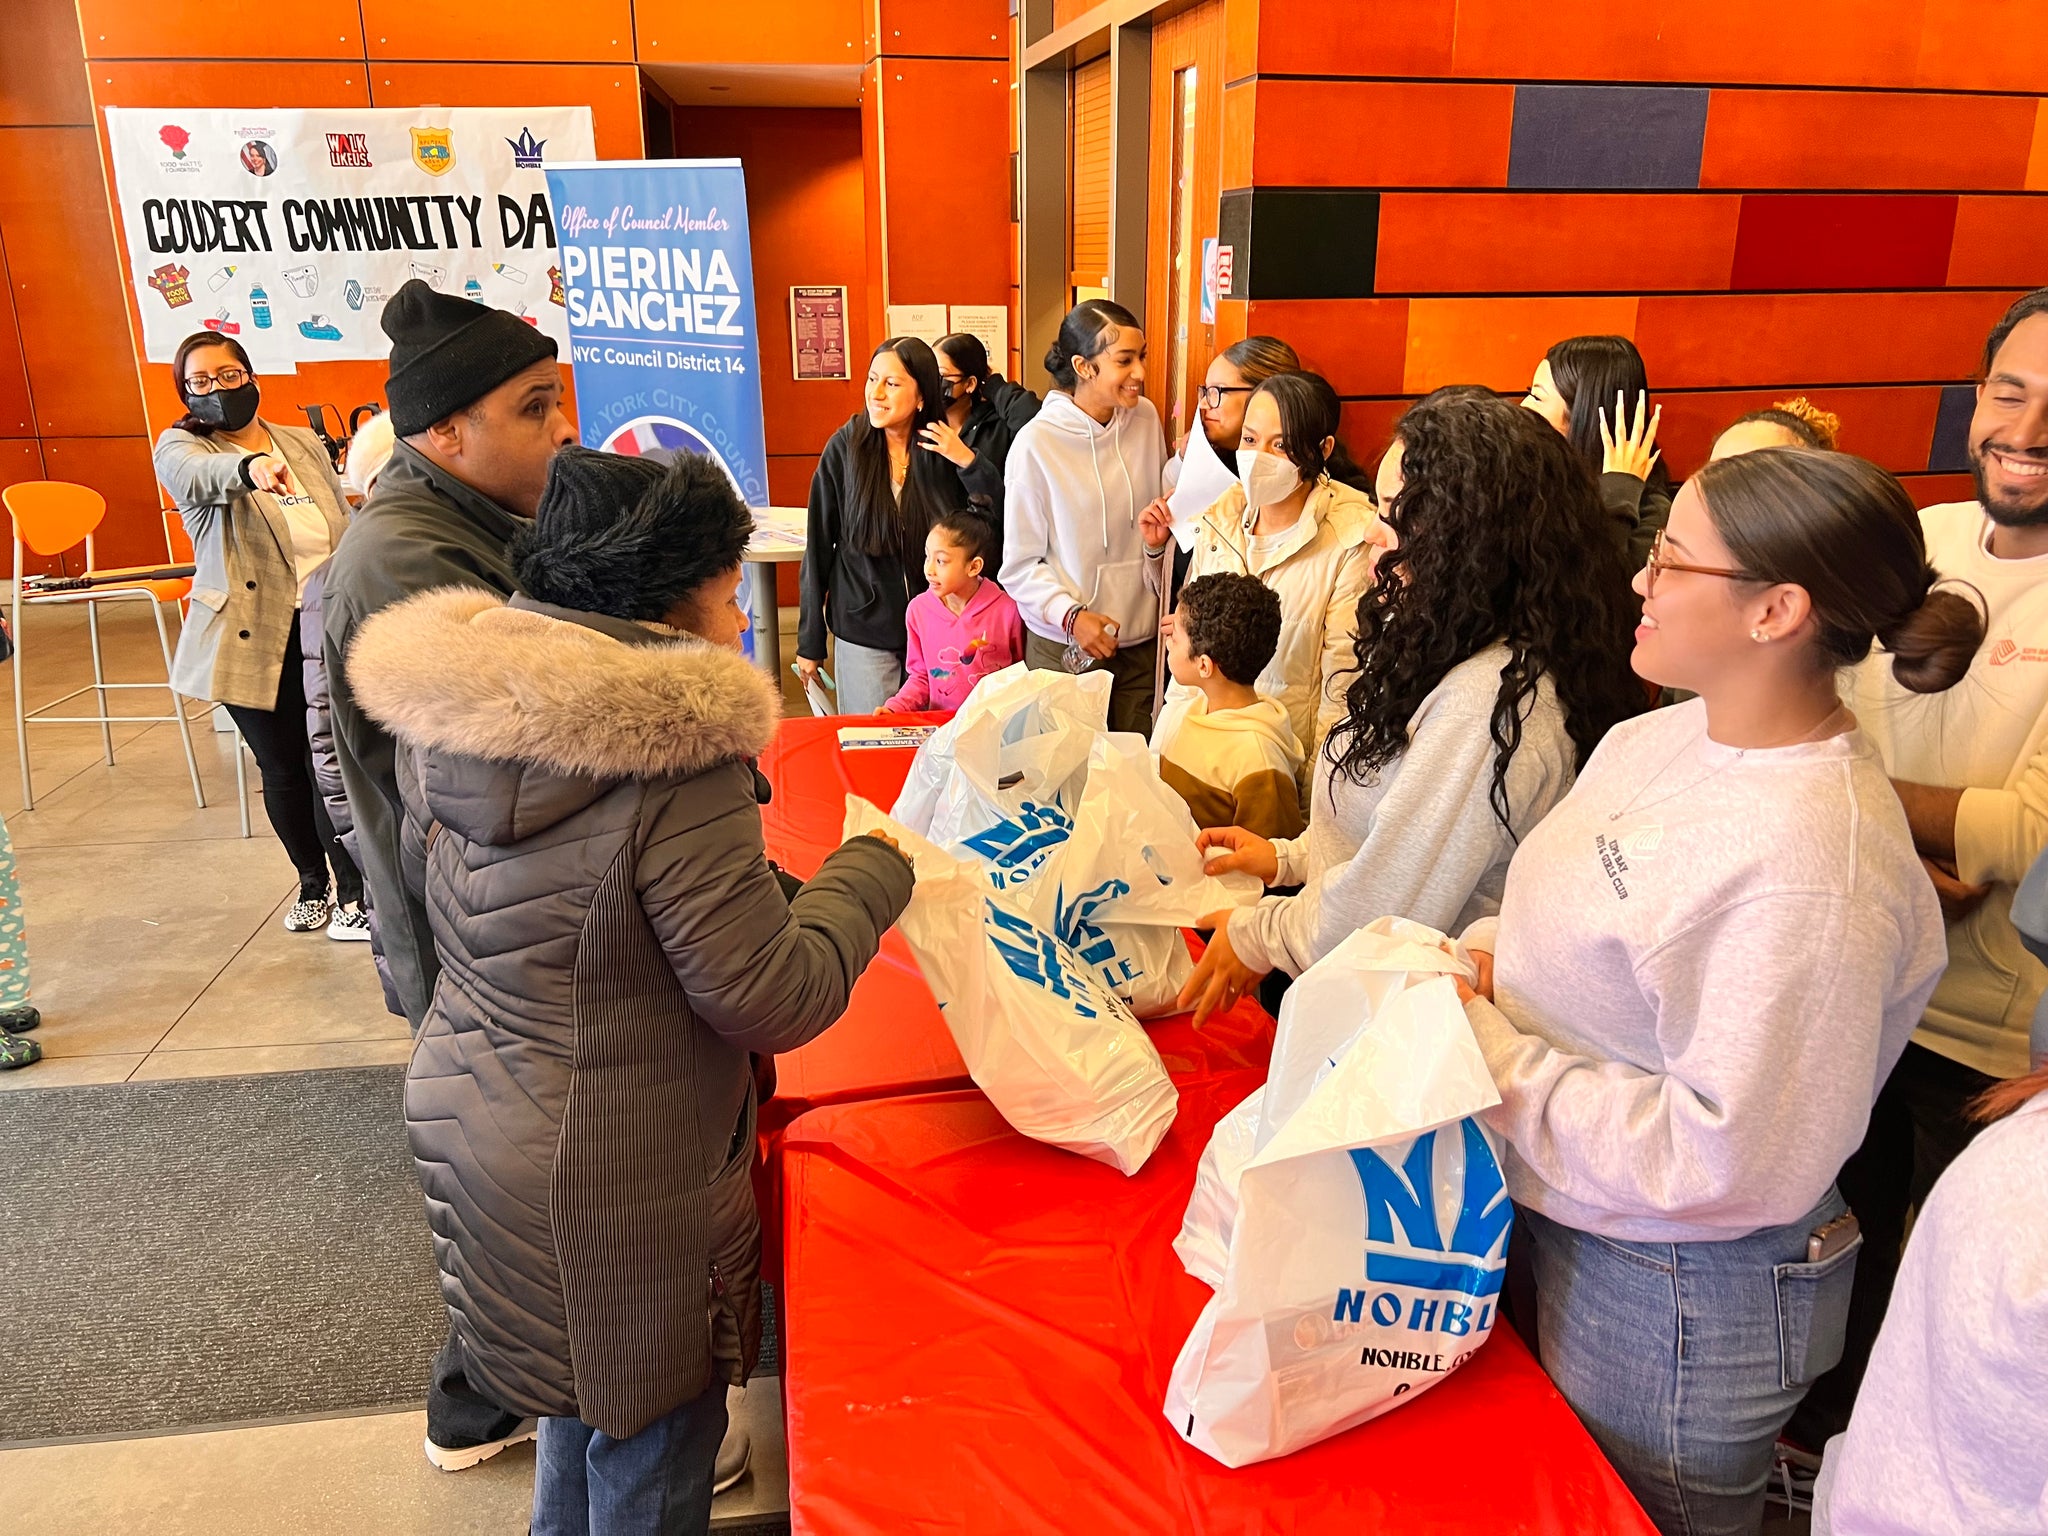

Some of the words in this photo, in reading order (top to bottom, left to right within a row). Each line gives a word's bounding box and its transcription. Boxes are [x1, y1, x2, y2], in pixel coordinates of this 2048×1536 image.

[326, 134, 368, 153] WALK
[143, 198, 272, 253] COUDERT
[282, 195, 482, 252] COMMUNITY
[499, 194, 556, 249] DA
[561, 204, 600, 238] Office
[603, 206, 620, 239] of
[621, 204, 673, 231] Council
[674, 204, 730, 234] Member
[563, 246, 740, 293] PIERINA
[166, 287, 186, 298] FOOD
[169, 294, 190, 305] DRIVE
[567, 288, 744, 336] SANCHEZ
[573, 345, 600, 363] NYC
[604, 347, 662, 368] Council
[667, 351, 722, 373] District
[725, 357, 745, 374] 14
[598, 391, 648, 425] YORK
[652, 388, 698, 418] CITY
[1601, 854, 1617, 878] GIRLS
[1613, 878, 1628, 899] CLUB
[1614, 855, 1628, 872] BAY
[1333, 1288, 1494, 1337] NOHBL
